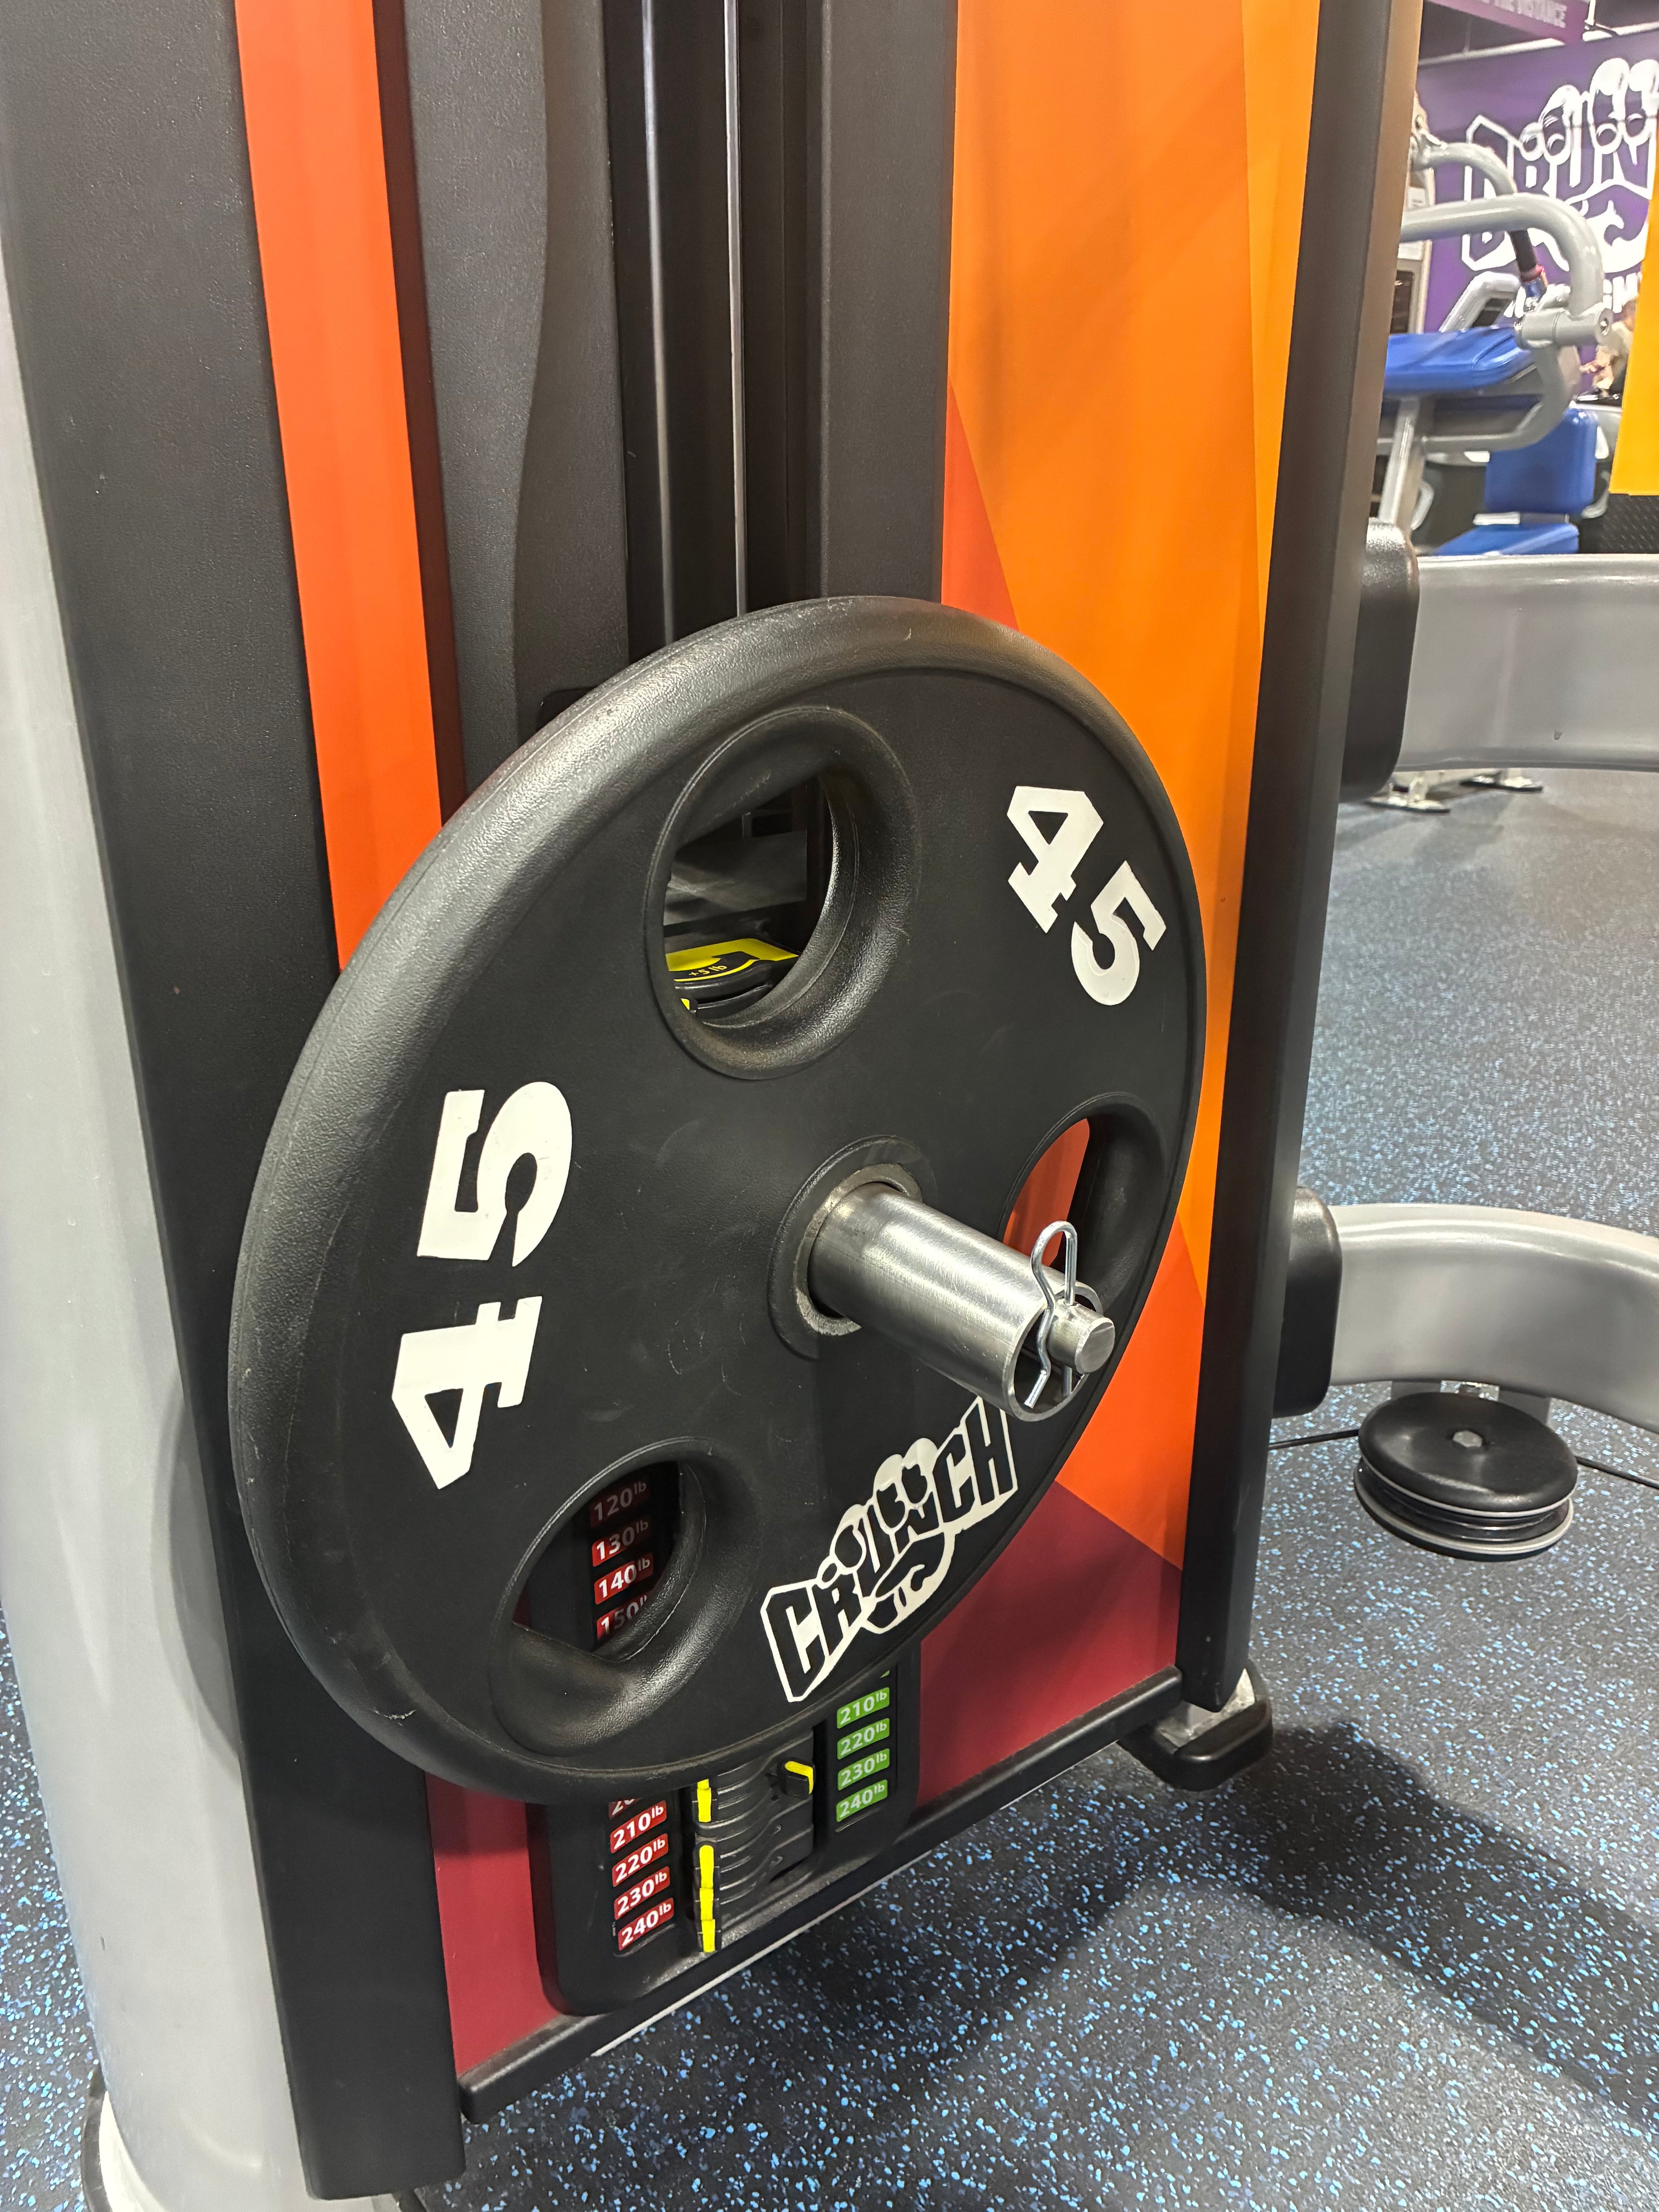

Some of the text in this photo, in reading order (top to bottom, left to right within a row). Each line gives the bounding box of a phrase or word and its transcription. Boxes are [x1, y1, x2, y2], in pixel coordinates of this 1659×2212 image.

[1007, 785, 1166, 1006] 45
[391, 1081, 572, 1490] 45
[760, 1396, 1018, 1703] CRUNCH
